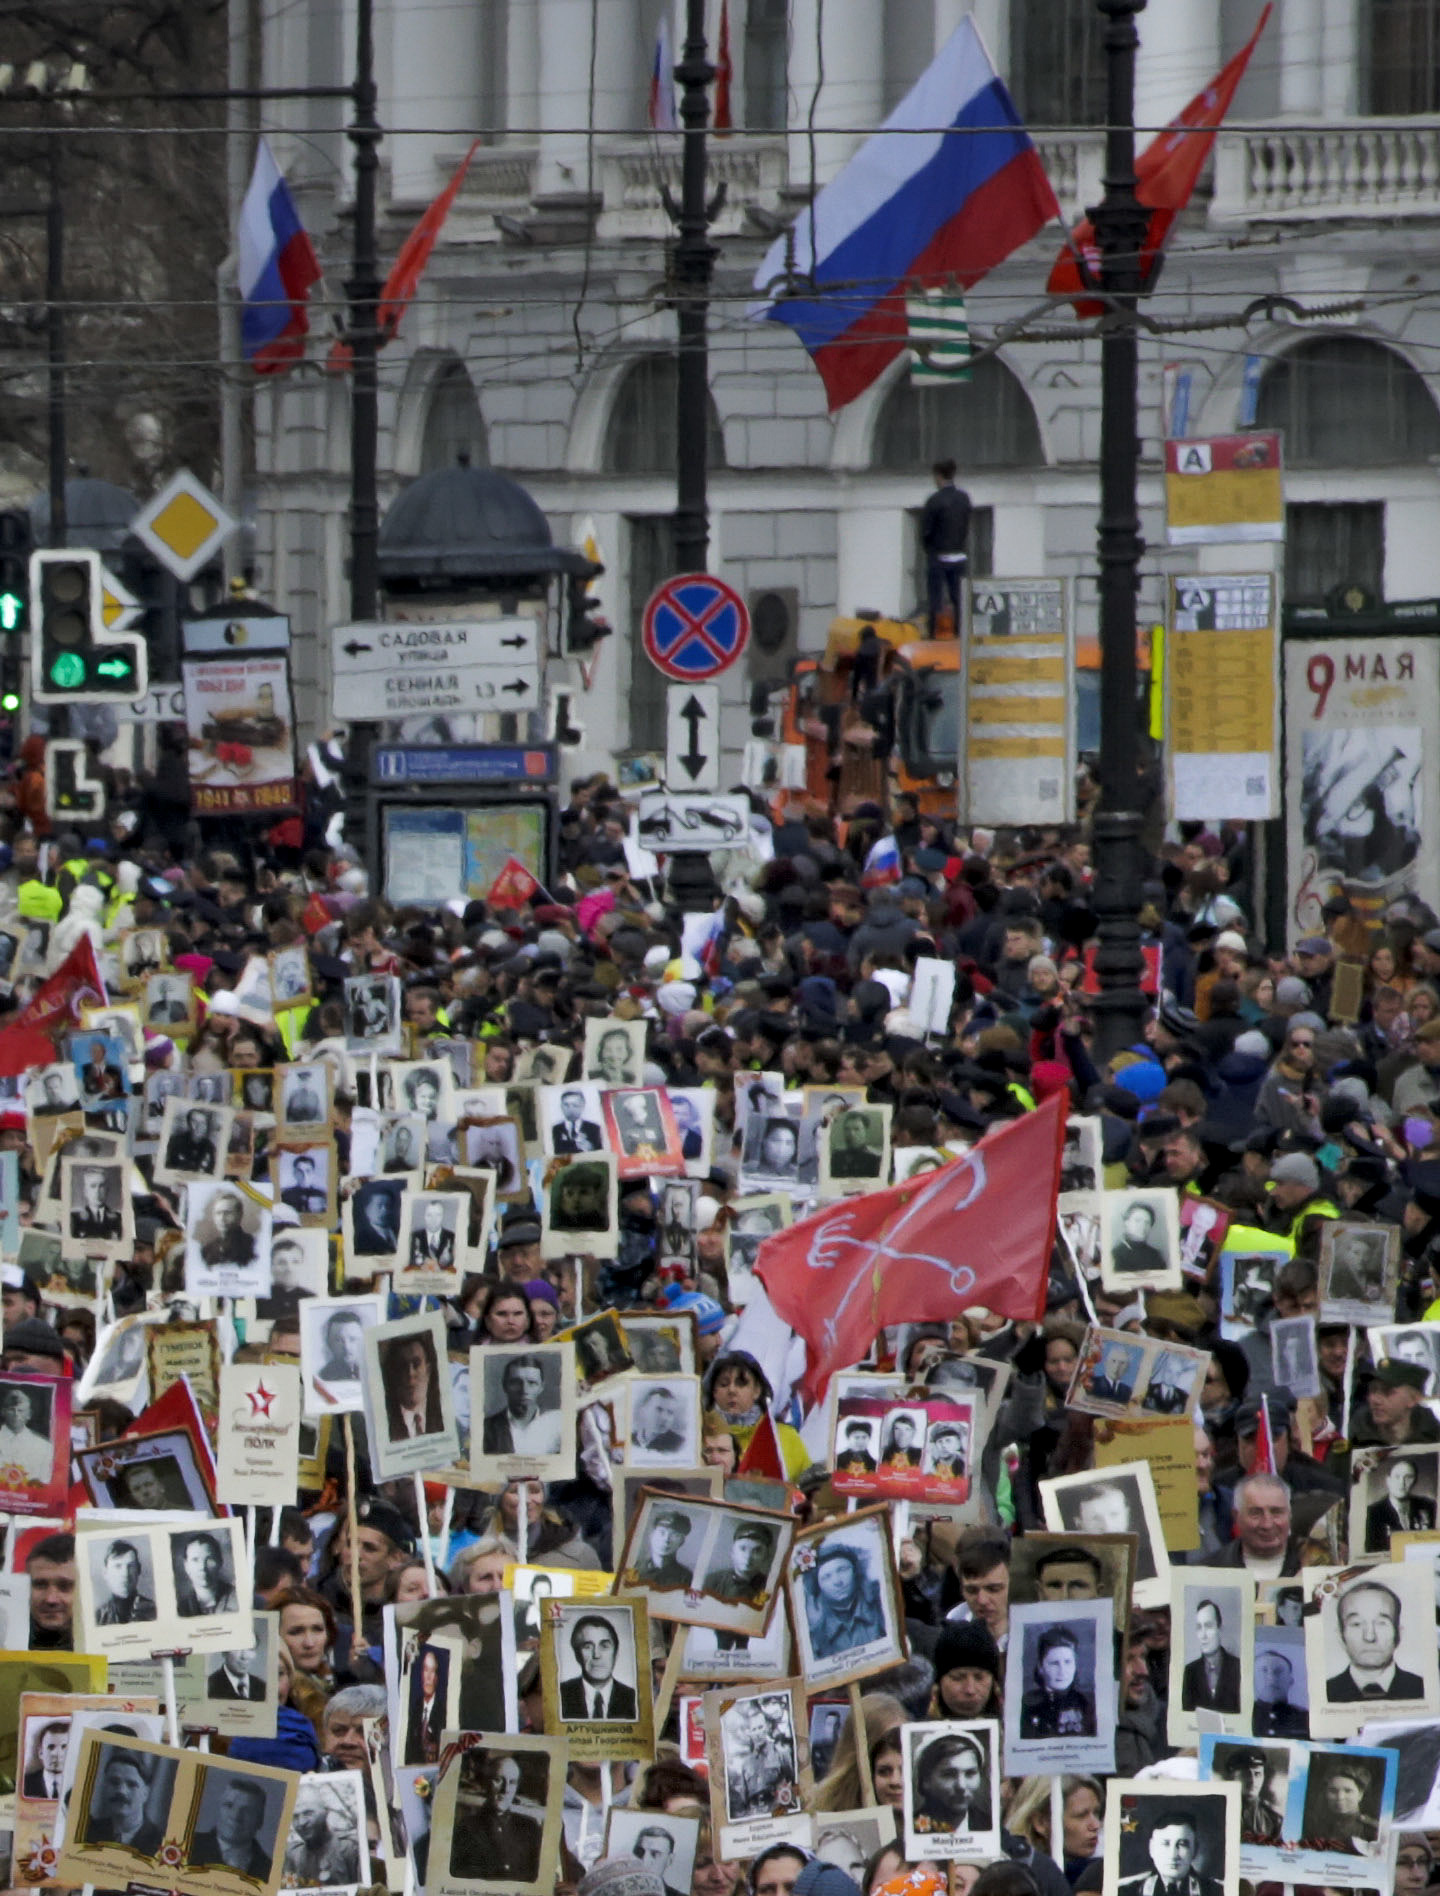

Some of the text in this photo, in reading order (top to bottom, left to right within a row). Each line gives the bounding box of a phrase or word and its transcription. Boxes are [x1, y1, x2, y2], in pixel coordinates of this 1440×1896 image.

[381, 631, 468, 648] САДОВАЯ
[384, 675, 460, 692] СЕННАЯ
[1305, 652, 1335, 720] 9
[1345, 652, 1415, 681] МАЯ
[244, 1436, 276, 1450] ПОЛК
